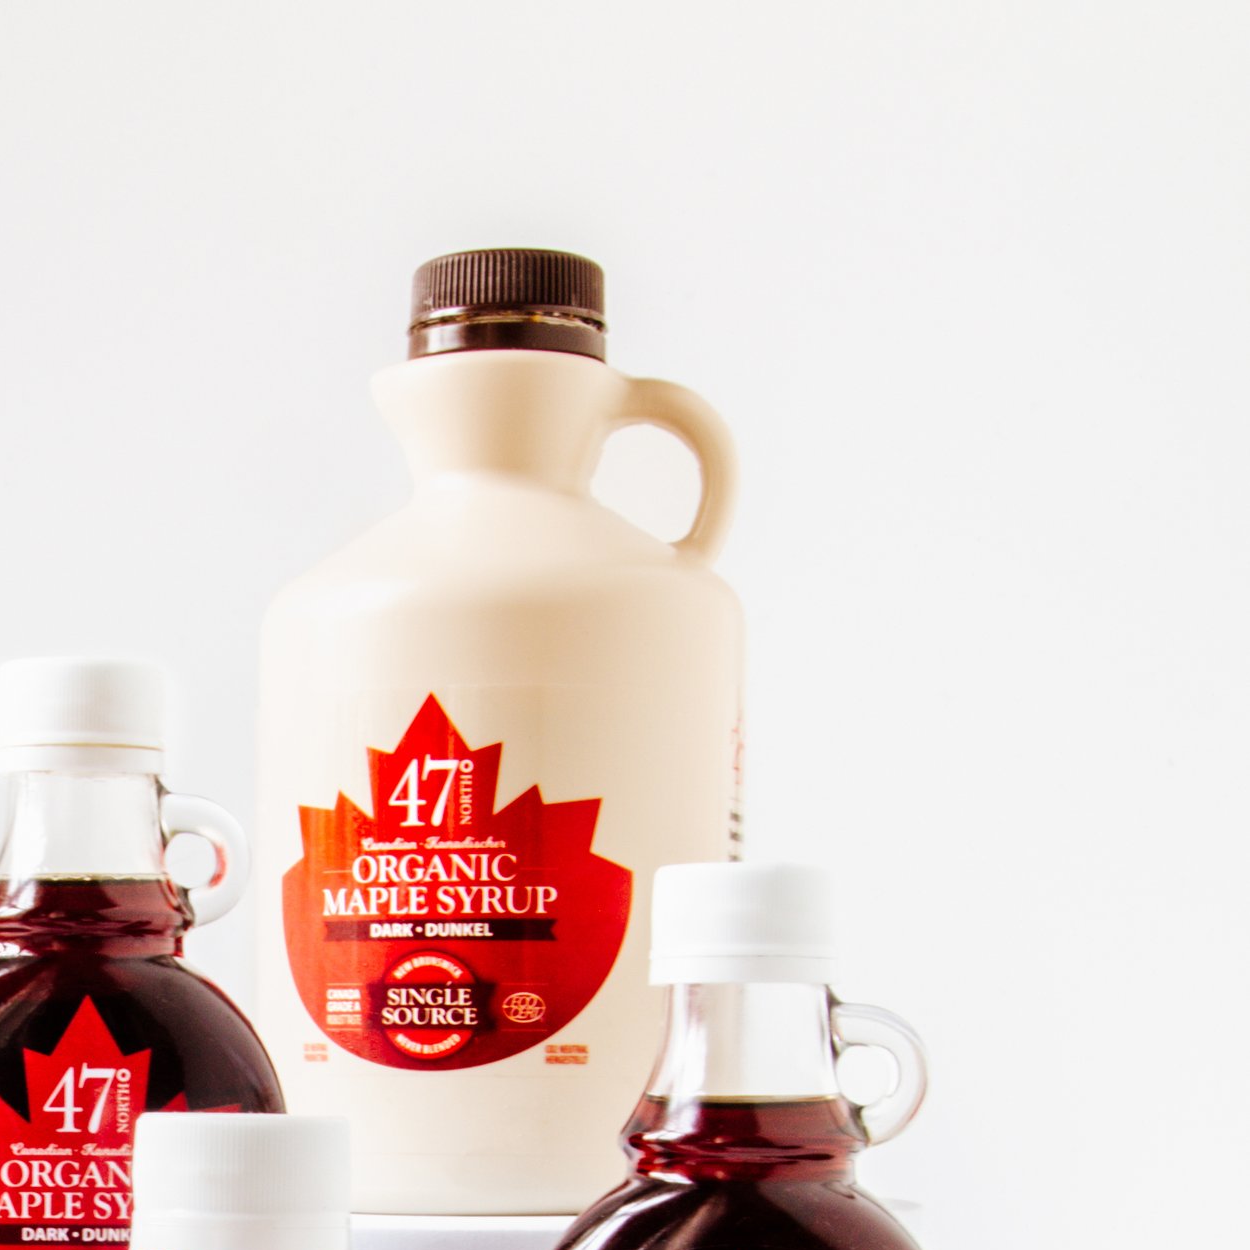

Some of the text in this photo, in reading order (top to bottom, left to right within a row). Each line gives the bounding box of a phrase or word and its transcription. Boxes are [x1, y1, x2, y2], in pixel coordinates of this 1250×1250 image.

[459, 774, 473, 825] NORTH
[361, 836, 506, 851] Canadian Kanadischer
[352, 854, 517, 883] ORGANIC
[323, 886, 558, 916] MAPLE SYRUP
[370, 922, 493, 938] DARK DUNKEL
[387, 988, 472, 1006] SINGLE
[381, 1007, 478, 1025] SOURCE
[116, 1083, 131, 1132] NORTH
[10, 1142, 133, 1156] Canadian Kanadi
[1, 1159, 132, 1188] ORGAN
[22, 1228, 131, 1242] DARK DUNK
